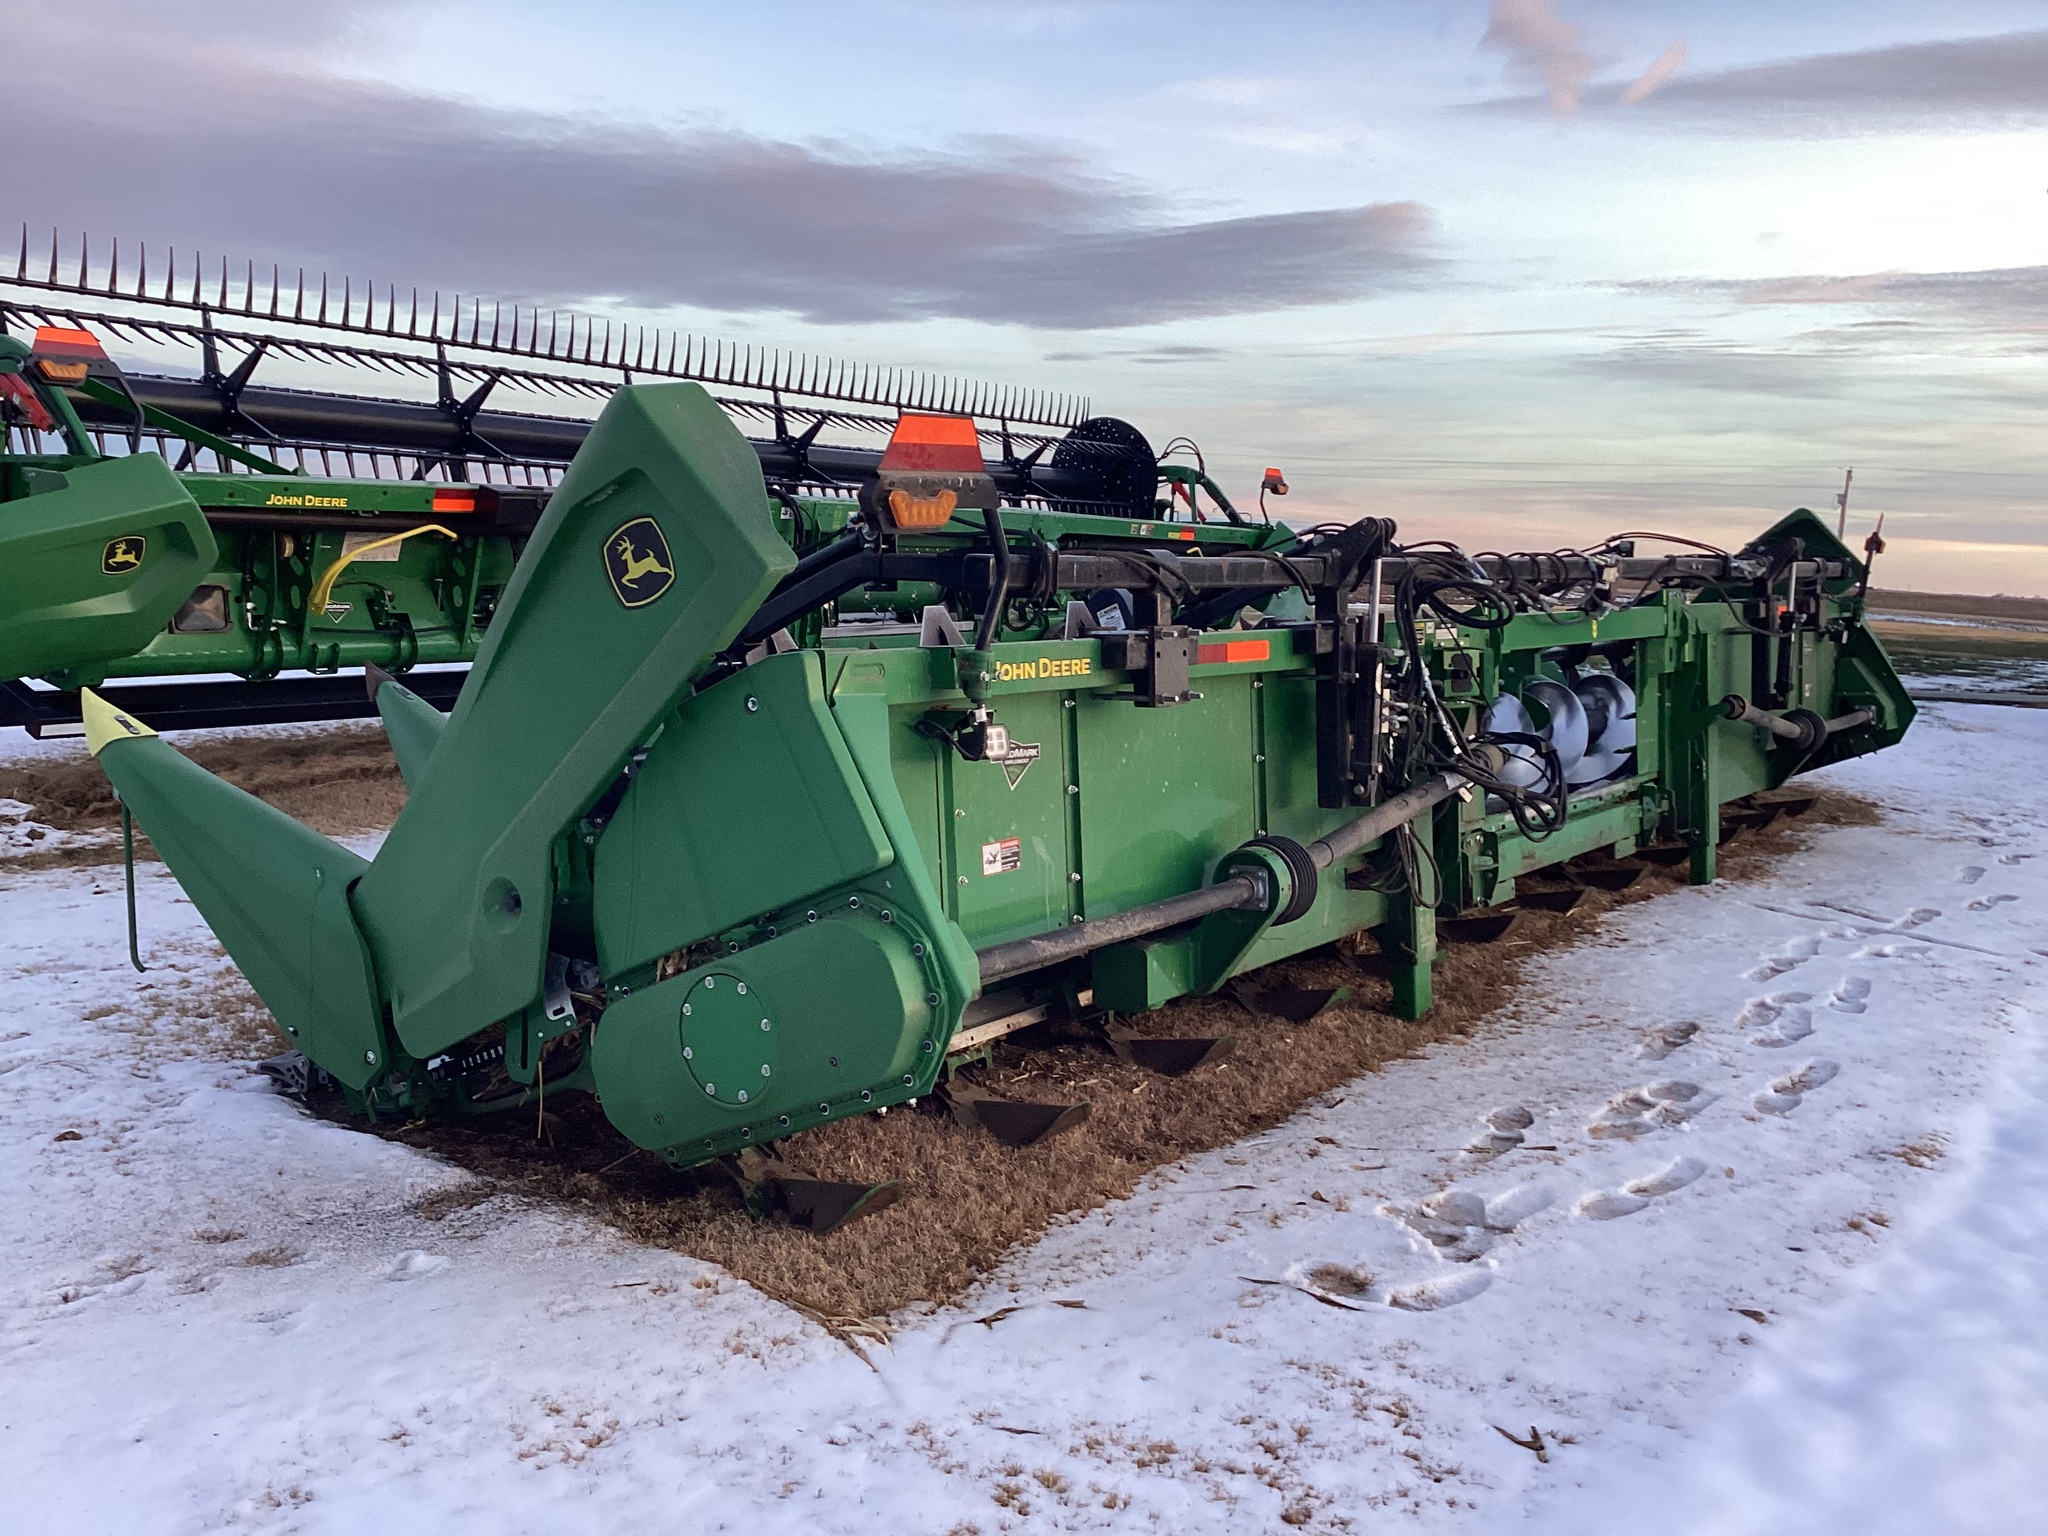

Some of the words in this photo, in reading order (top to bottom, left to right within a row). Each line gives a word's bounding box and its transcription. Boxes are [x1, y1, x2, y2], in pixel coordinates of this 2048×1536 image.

[265, 493, 302, 506] JOHN
[304, 494, 348, 508] DEERE
[1038, 657, 1092, 679] DEERE
